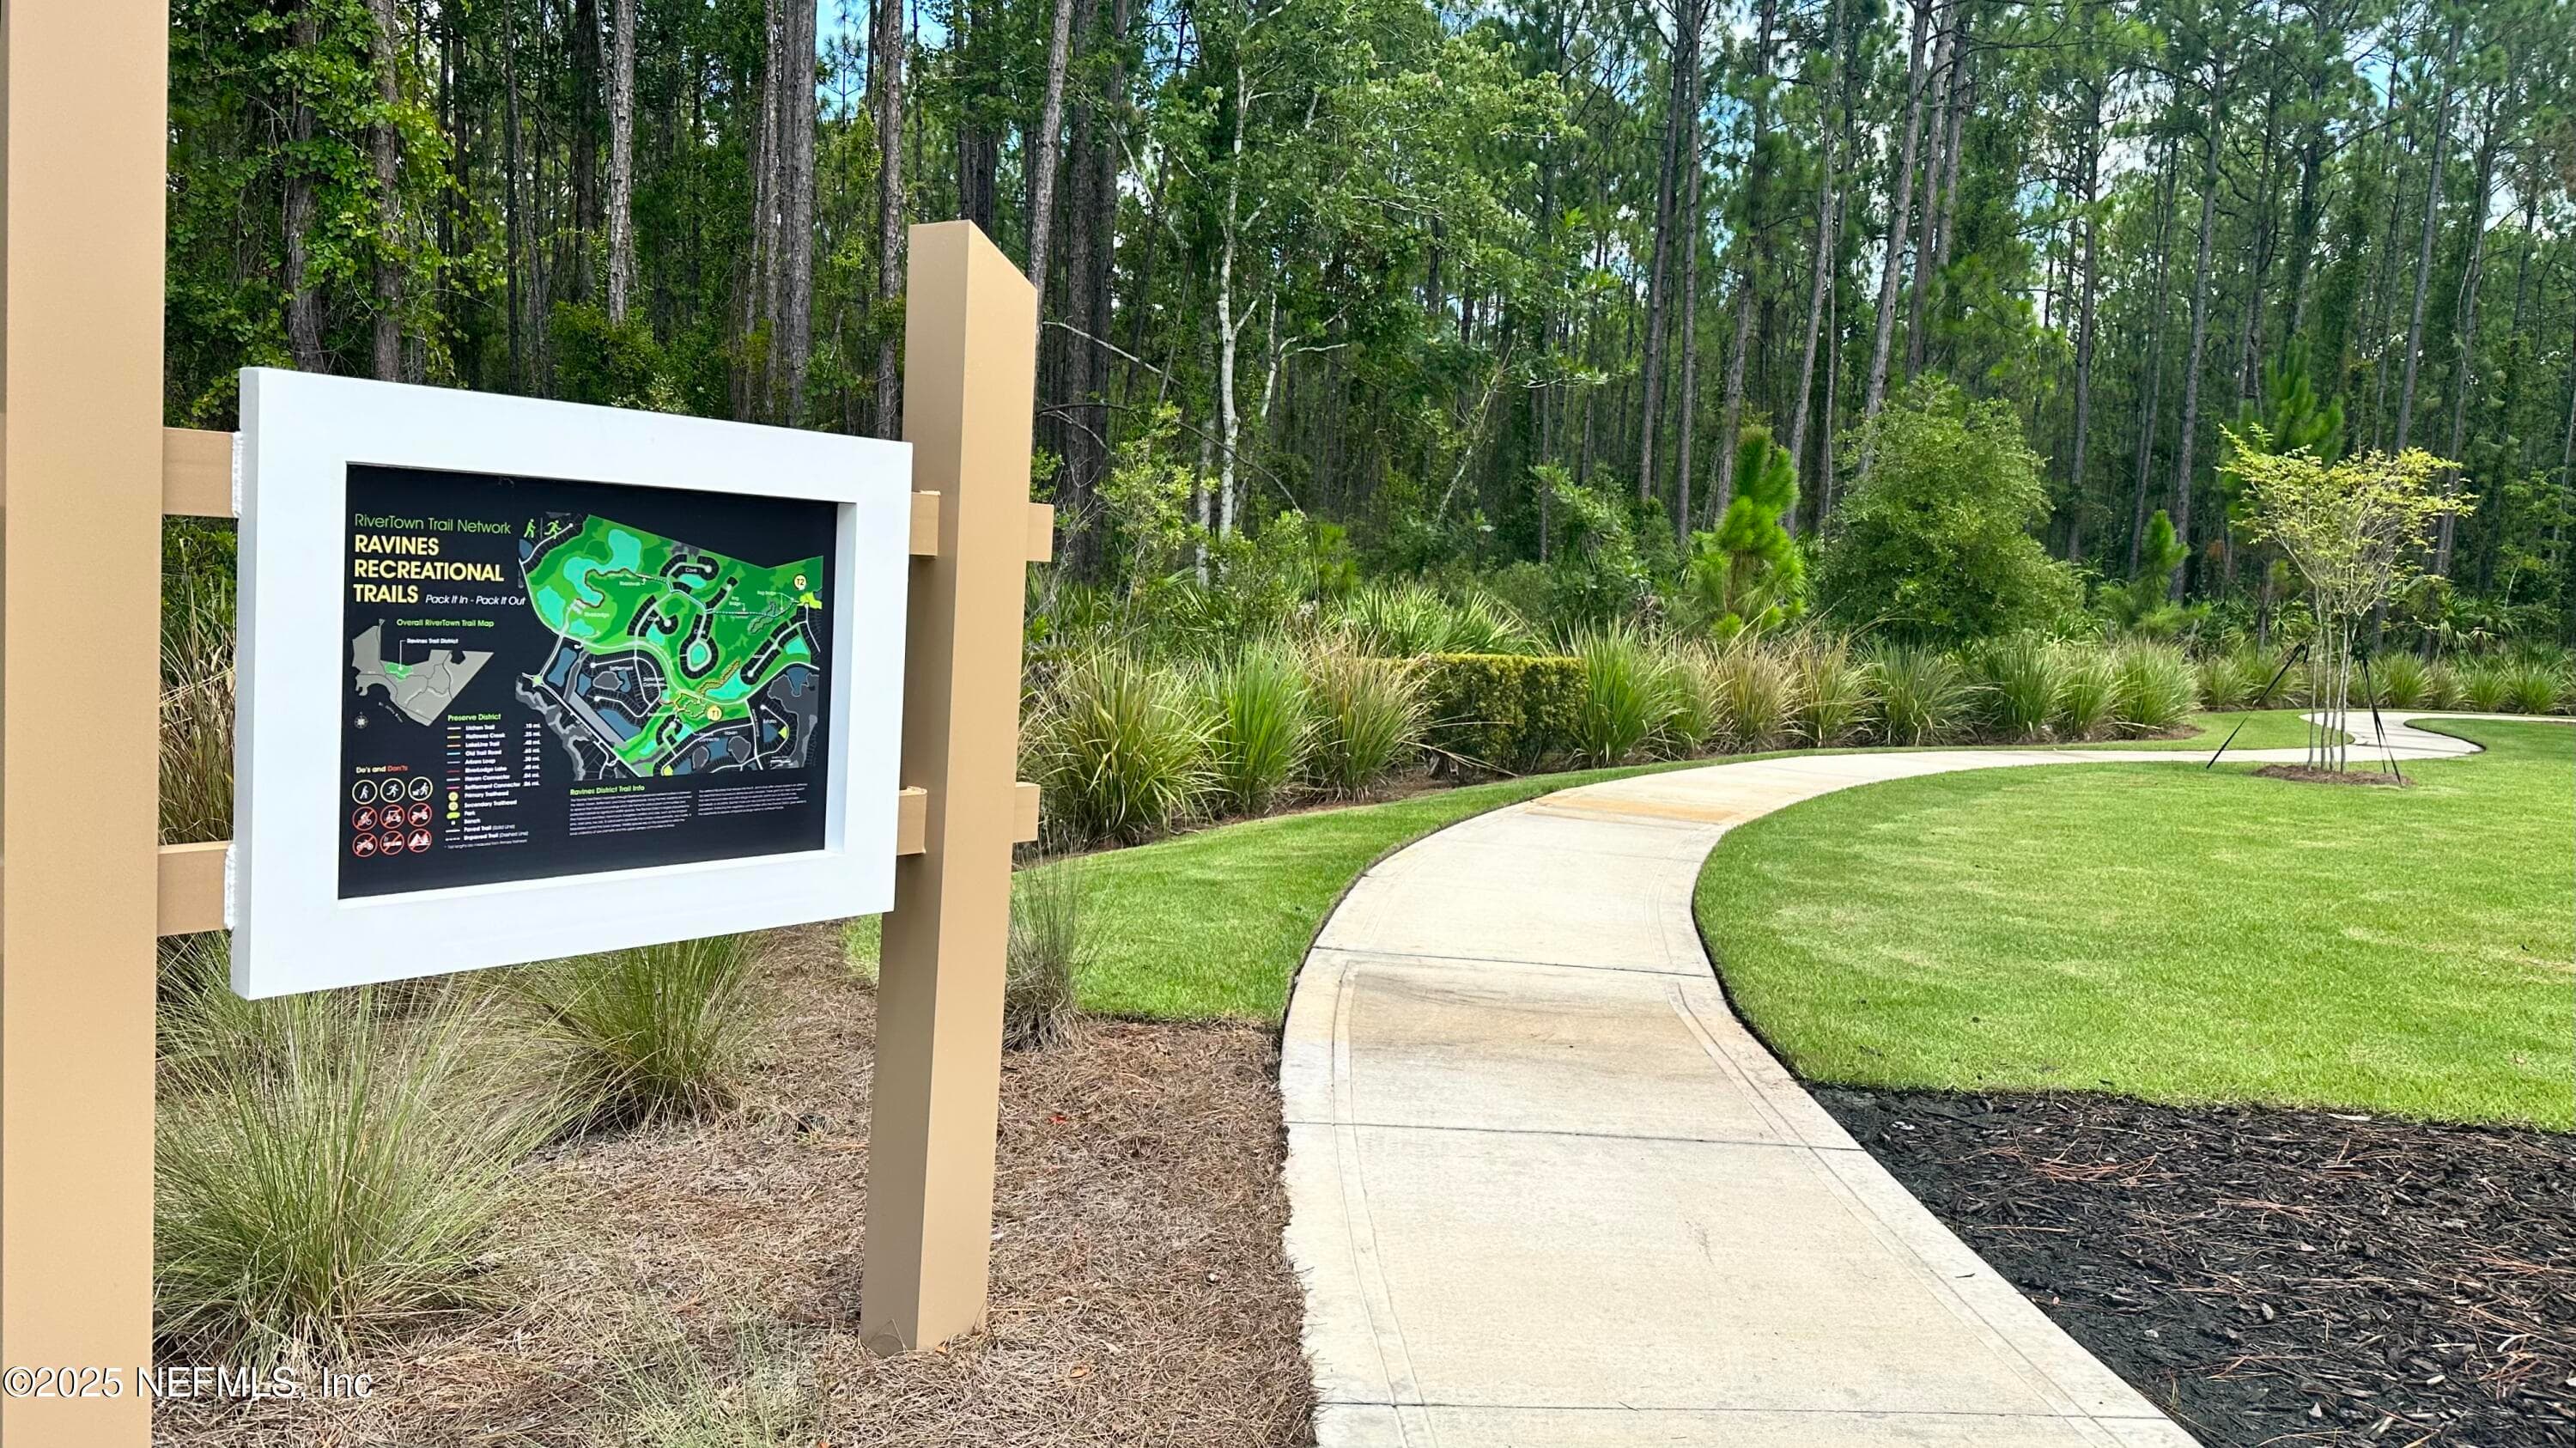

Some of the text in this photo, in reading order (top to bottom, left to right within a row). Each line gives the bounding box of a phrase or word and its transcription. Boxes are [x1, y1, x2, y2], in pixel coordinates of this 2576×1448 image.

[355, 514, 512, 534] RiverTown Trail Network
[354, 534, 440, 556] RAVINES
[354, 558, 505, 582] RECREATIONAL
[353, 583, 419, 604] TRAILS
[425, 593, 450, 604] Pack
[451, 594, 459, 604] It
[459, 595, 468, 604] In
[475, 595, 500, 605] Pack
[501, 596, 507, 605] It
[508, 596, 526, 605] Out
[425, 618, 460, 627] RiverTown
[477, 619, 495, 628] Map
[596, 786, 618, 794] District
